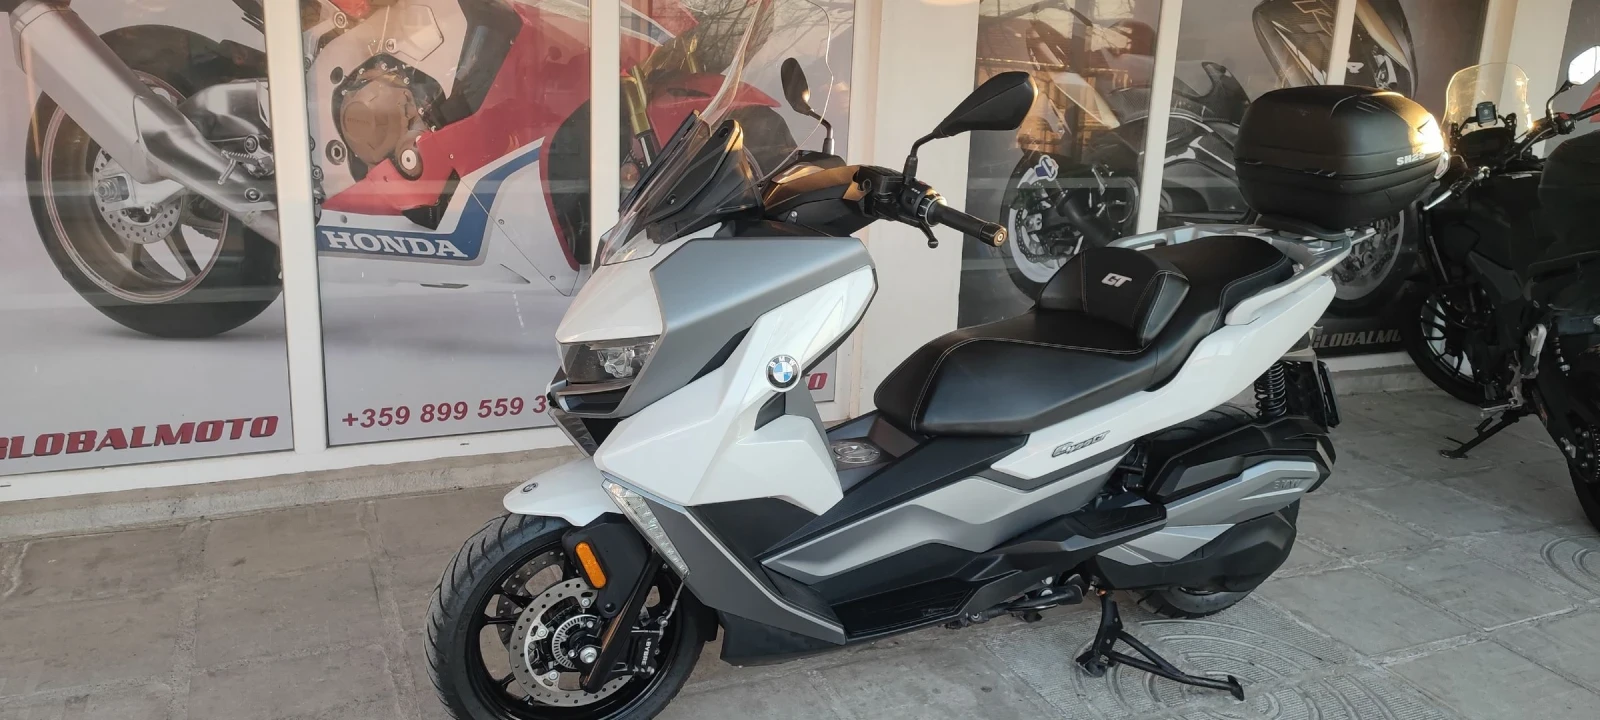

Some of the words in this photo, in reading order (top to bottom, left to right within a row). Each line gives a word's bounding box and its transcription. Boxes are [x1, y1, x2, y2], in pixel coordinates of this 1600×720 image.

[321, 230, 469, 258] HONDA
[1101, 272, 1133, 288] GT
[342, 405, 411, 429] +359
[420, 401, 468, 423] 899
[477, 396, 524, 418] 559
